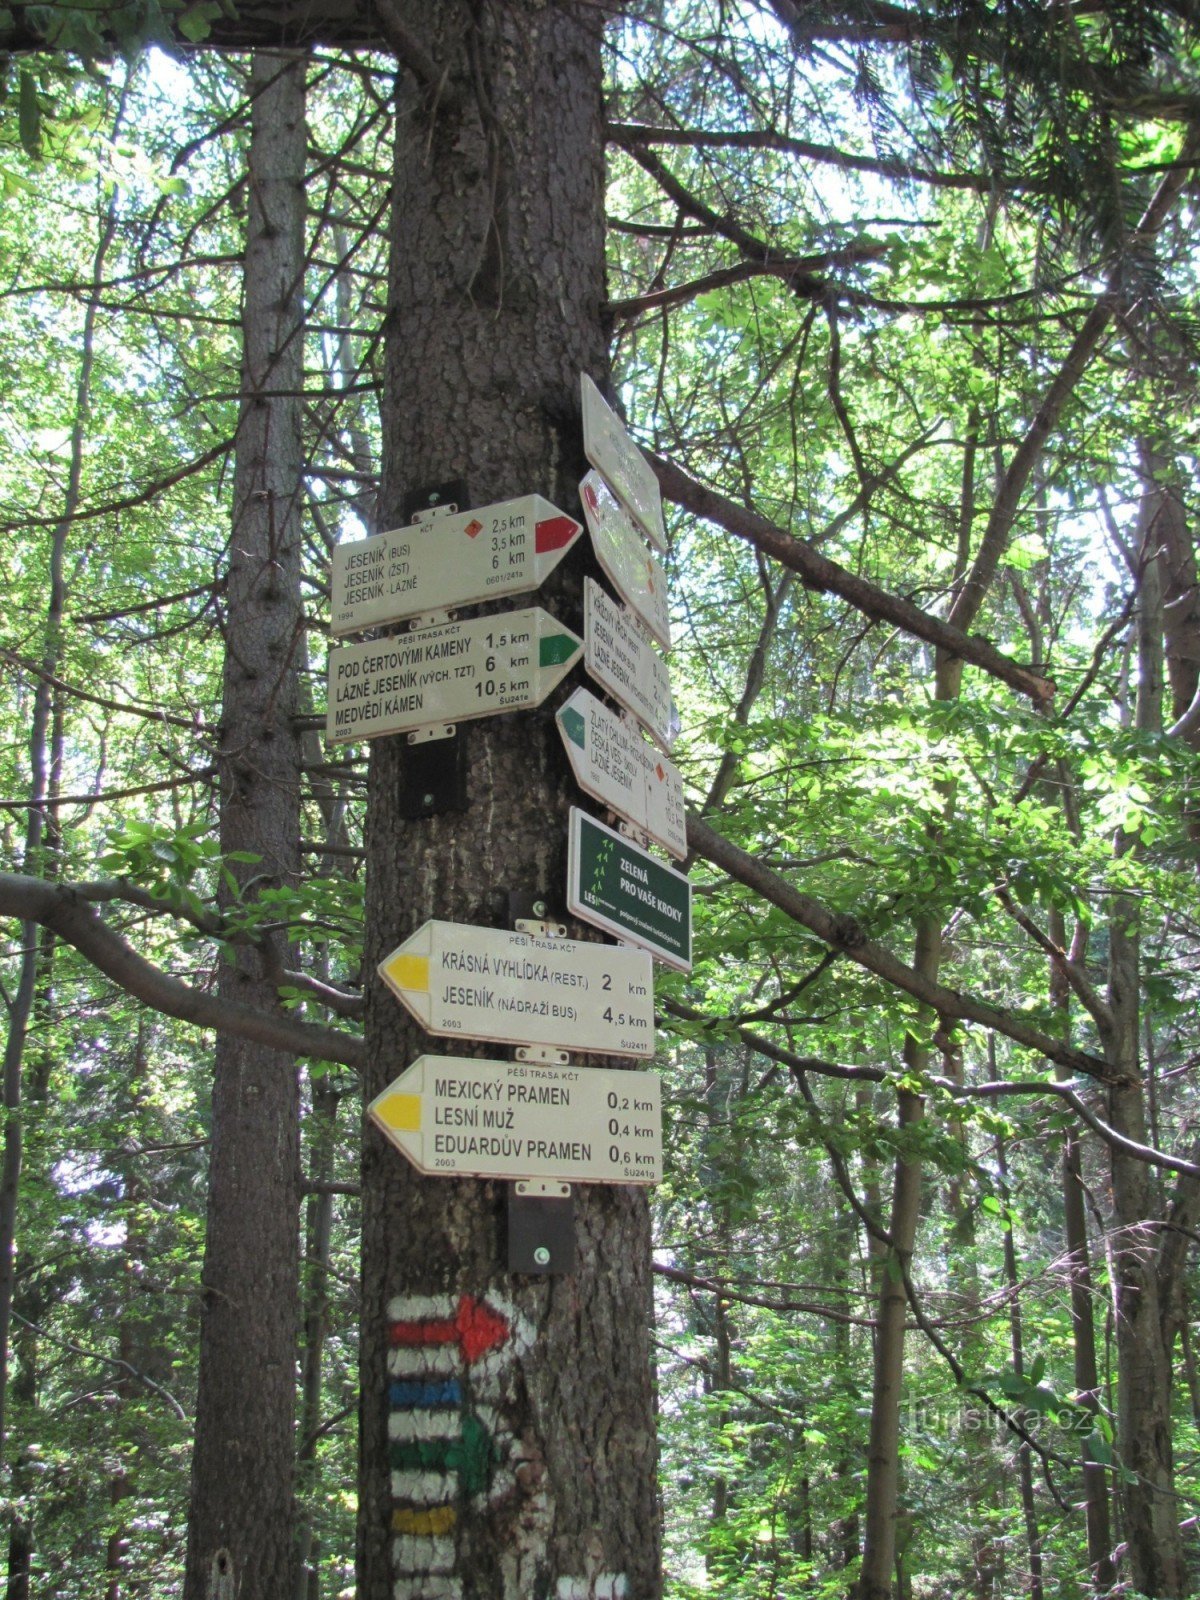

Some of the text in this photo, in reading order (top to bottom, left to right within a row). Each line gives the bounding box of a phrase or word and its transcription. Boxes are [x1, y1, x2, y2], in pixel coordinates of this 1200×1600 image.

[420, 524, 433, 533] KČT
[492, 516, 525, 534] 2,5 km
[492, 534, 525, 552] 3,5 km
[345, 544, 410, 570] JESENÍK (BUS)
[492, 552, 525, 569] 6 km
[343, 562, 410, 588] JESENÍK (ŽST)
[343, 582, 384, 605] JESENÍK
[338, 612, 354, 621] 1994
[398, 626, 461, 645] PĚŠÍ TRASA KČT
[486, 633, 529, 649] 1,5 km
[338, 638, 471, 679] POD ČERTOVÝMI KAMENY
[486, 656, 529, 672] 6 km
[337, 681, 370, 702] LÁZNĚ
[373, 671, 417, 695] JESENÍK
[455, 666, 475, 678] TZT)
[475, 680, 529, 698] 10,5 km
[335, 694, 423, 725] MEDVĚDÍ KÁMEN
[335, 728, 352, 737] 2003
[620, 858, 649, 885] ZELENÁ
[620, 877, 636, 896] PRO
[637, 887, 656, 908] VAŠE
[657, 898, 682, 923] KROKY
[509, 936, 576, 953] PĚŠÍ TRASA KČT
[442, 950, 589, 991] KRÁSNÁ VYHLÍDKA (REST.)
[602, 974, 647, 995] 2 km
[442, 986, 577, 1022] JESENÍK (NÁDRAŽÍ BUS)
[442, 1019, 461, 1029] 2003
[603, 1007, 647, 1028] 4,5 km
[507, 1068, 579, 1081] PĚŠÍ TRASA KČT
[435, 1078, 570, 1106] MEXICKÝ PRAMEN
[607, 1092, 653, 1112] 0,2 km
[435, 1106, 514, 1129] LESNÍ MUŽ
[608, 1119, 654, 1138] 0,4 km
[435, 1133, 591, 1161] EDUARDŮV PRAMEN
[609, 1145, 655, 1165] 0,6 km
[435, 1158, 456, 1168] 2003
